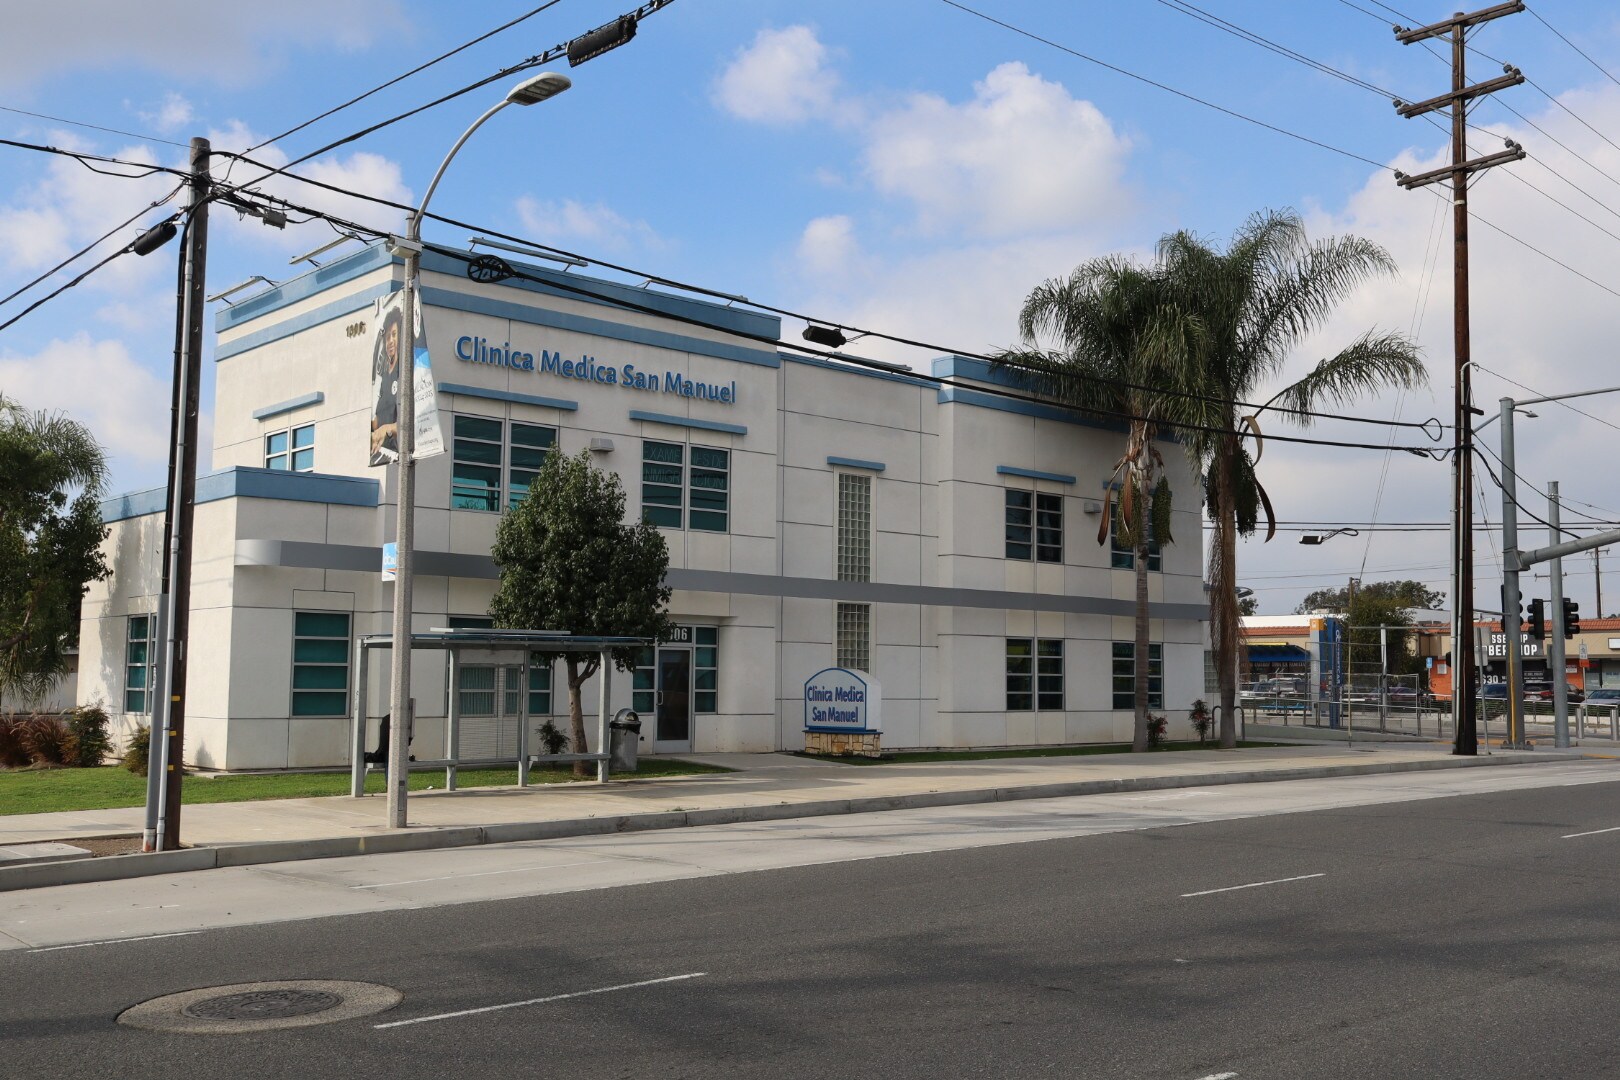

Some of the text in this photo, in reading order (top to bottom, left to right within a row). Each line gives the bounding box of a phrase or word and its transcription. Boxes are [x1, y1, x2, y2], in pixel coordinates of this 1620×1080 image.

[455, 335, 737, 404] Clinica Medica San Manuel
[807, 685, 865, 703] Clinica Medica
[812, 706, 859, 723] San Manuel
